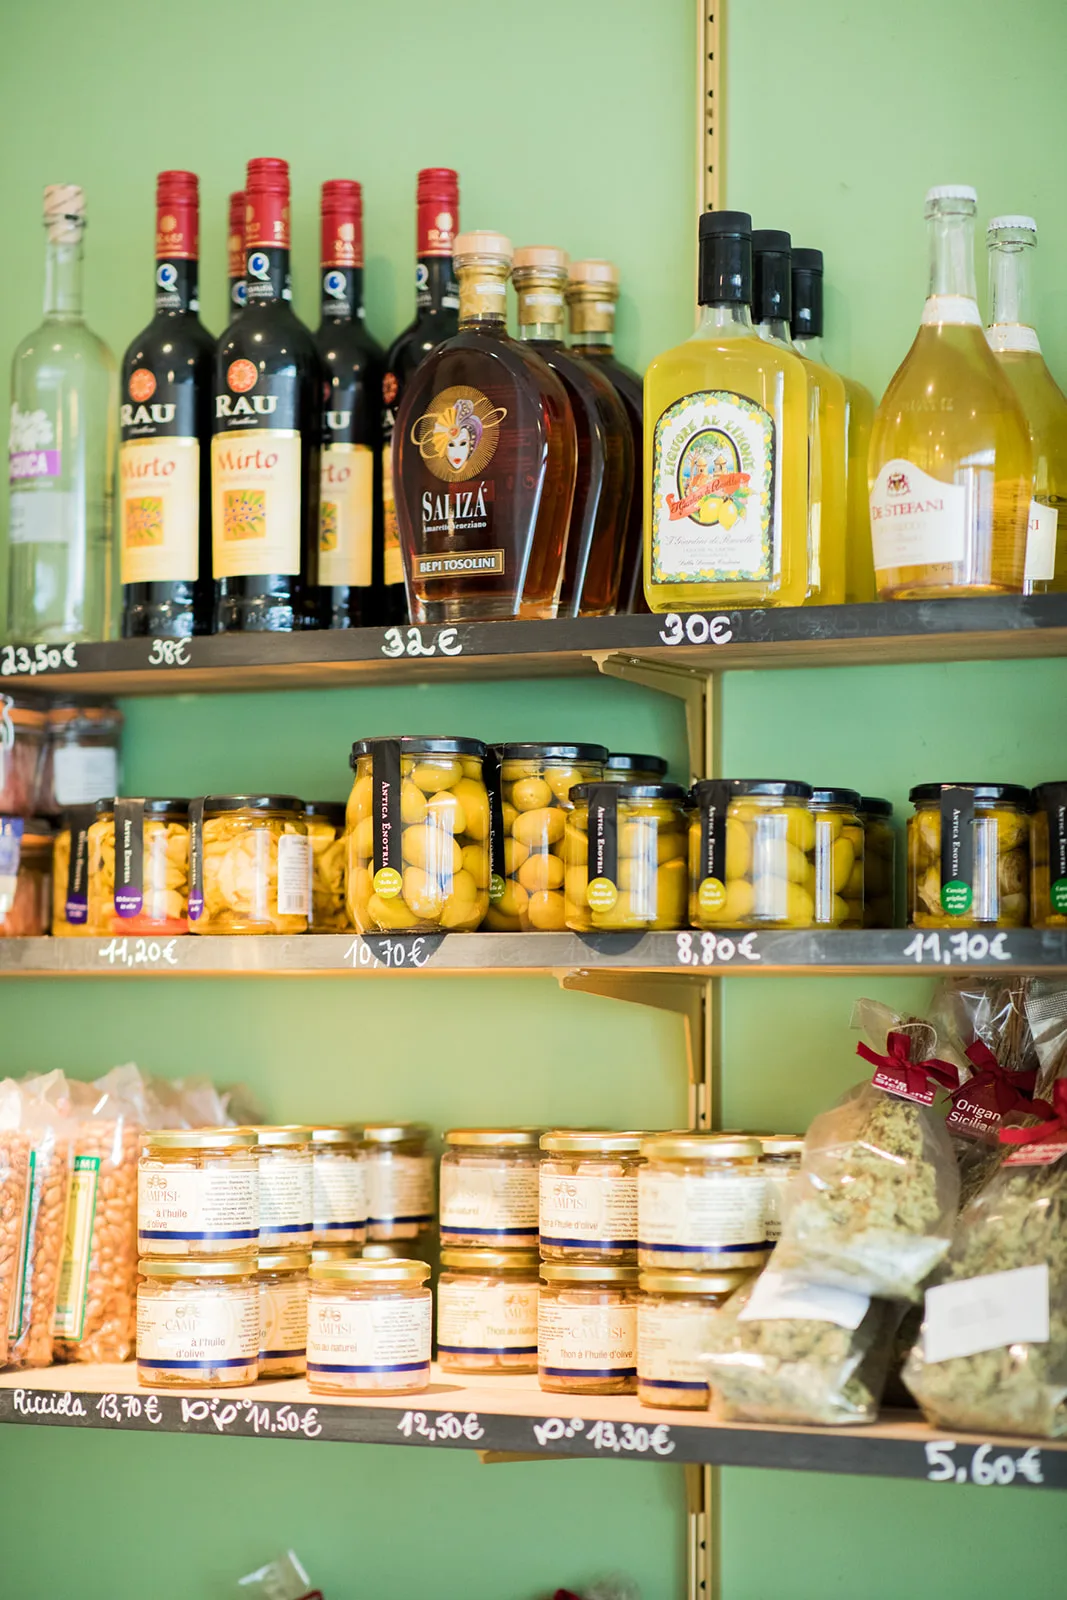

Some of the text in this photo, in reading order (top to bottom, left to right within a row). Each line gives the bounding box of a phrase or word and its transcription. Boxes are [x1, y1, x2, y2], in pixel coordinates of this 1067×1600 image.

[120, 404, 176, 426] RAU
[216, 395, 278, 418] RAU
[218, 449, 278, 470] Mirto
[884, 498, 944, 518] STEFANI
[420, 556, 496, 573] BEPI TOSOLINI
[382, 628, 462, 658] 32€
[659, 613, 732, 645] 30€
[1, 641, 78, 676] 23,50€
[148, 636, 192, 665] 38€
[98, 938, 178, 968] 11,20€
[344, 938, 430, 968] 10,70€
[676, 932, 762, 966] 8,80€
[903, 930, 1012, 966] 11,70€
[948, 1111, 1001, 1136] Sicilian
[955, 1099, 1001, 1122] Origan
[609, 1350, 632, 1359] d'olive
[96, 1394, 162, 1424] 13,70€
[398, 1411, 484, 1440] 12,50€
[586, 1420, 676, 1454] 13,30€
[924, 1440, 1044, 1485] 5,60€
